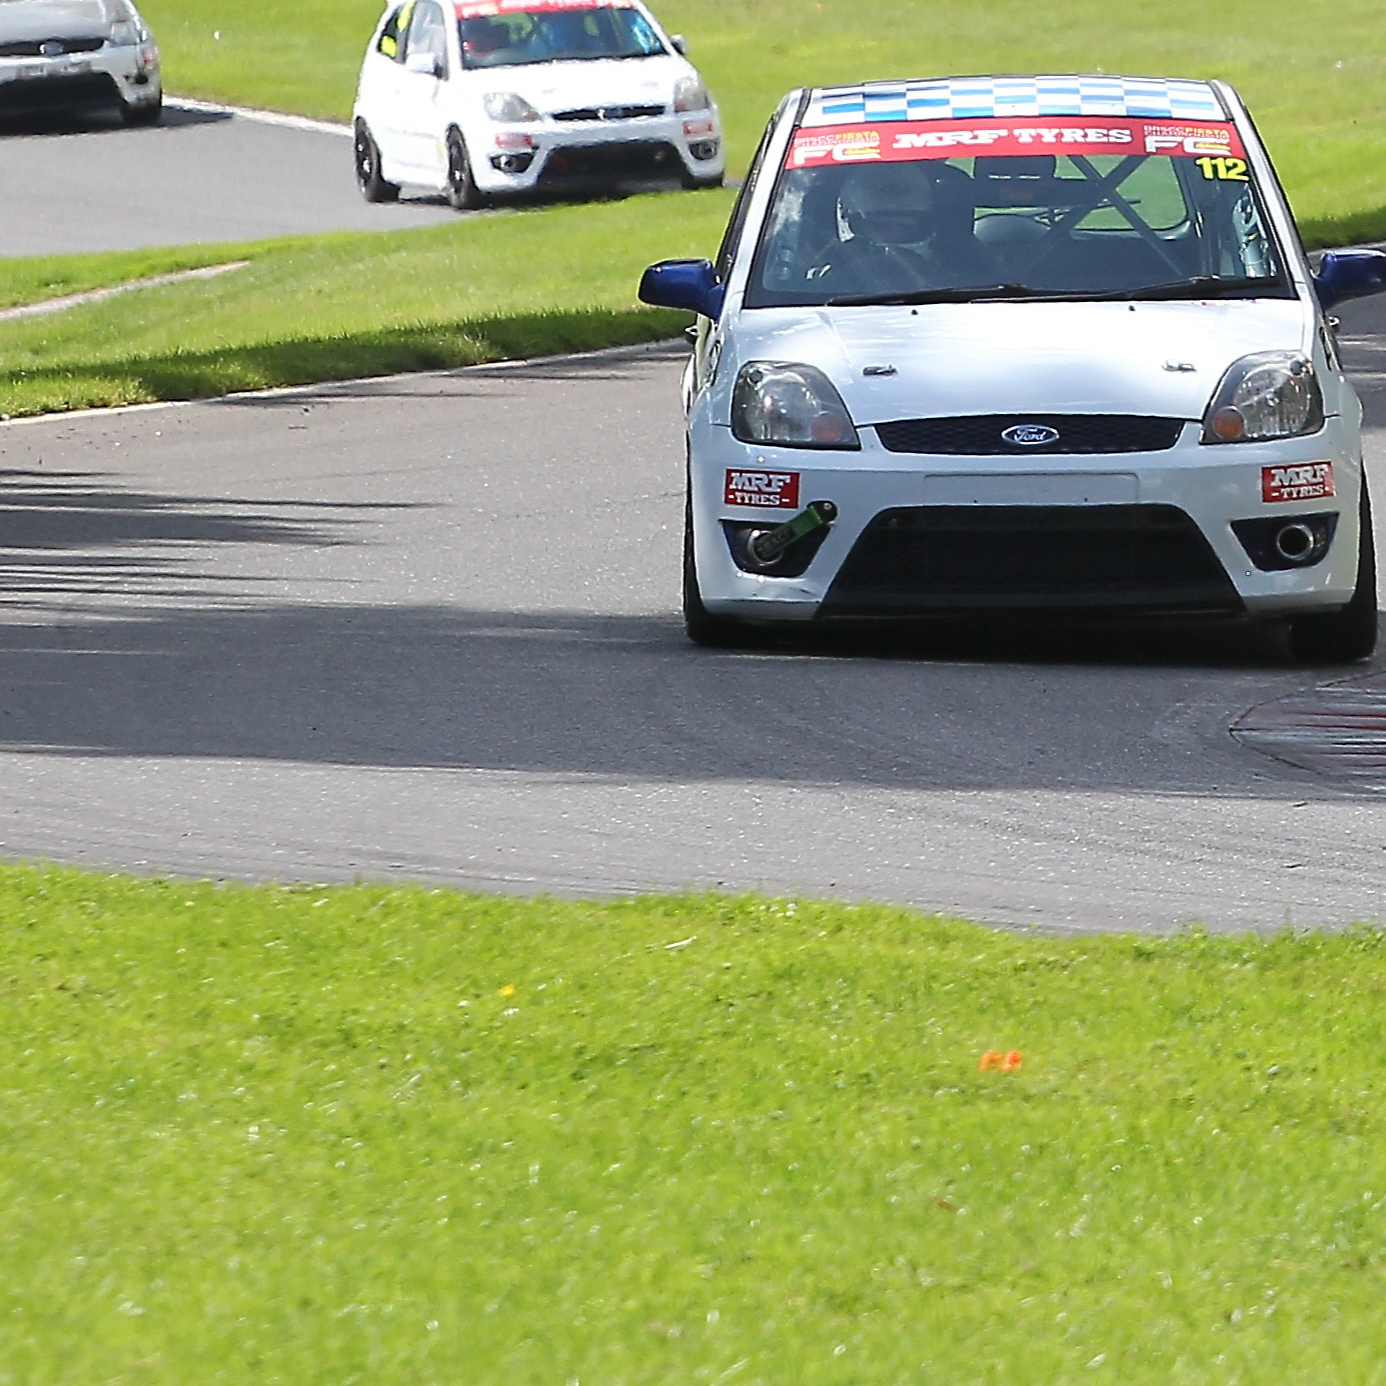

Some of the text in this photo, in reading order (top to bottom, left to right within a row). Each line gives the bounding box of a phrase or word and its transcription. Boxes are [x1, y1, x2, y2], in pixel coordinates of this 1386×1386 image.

[892, 128, 1133, 150] MRF TYRES
[1145, 136, 1232, 155] FC
[793, 141, 882, 165] FC
[1195, 157, 1250, 181] 112
[1013, 428, 1047, 442] Ford
[729, 472, 791, 493] MRF
[1270, 464, 1329, 487] MRF
